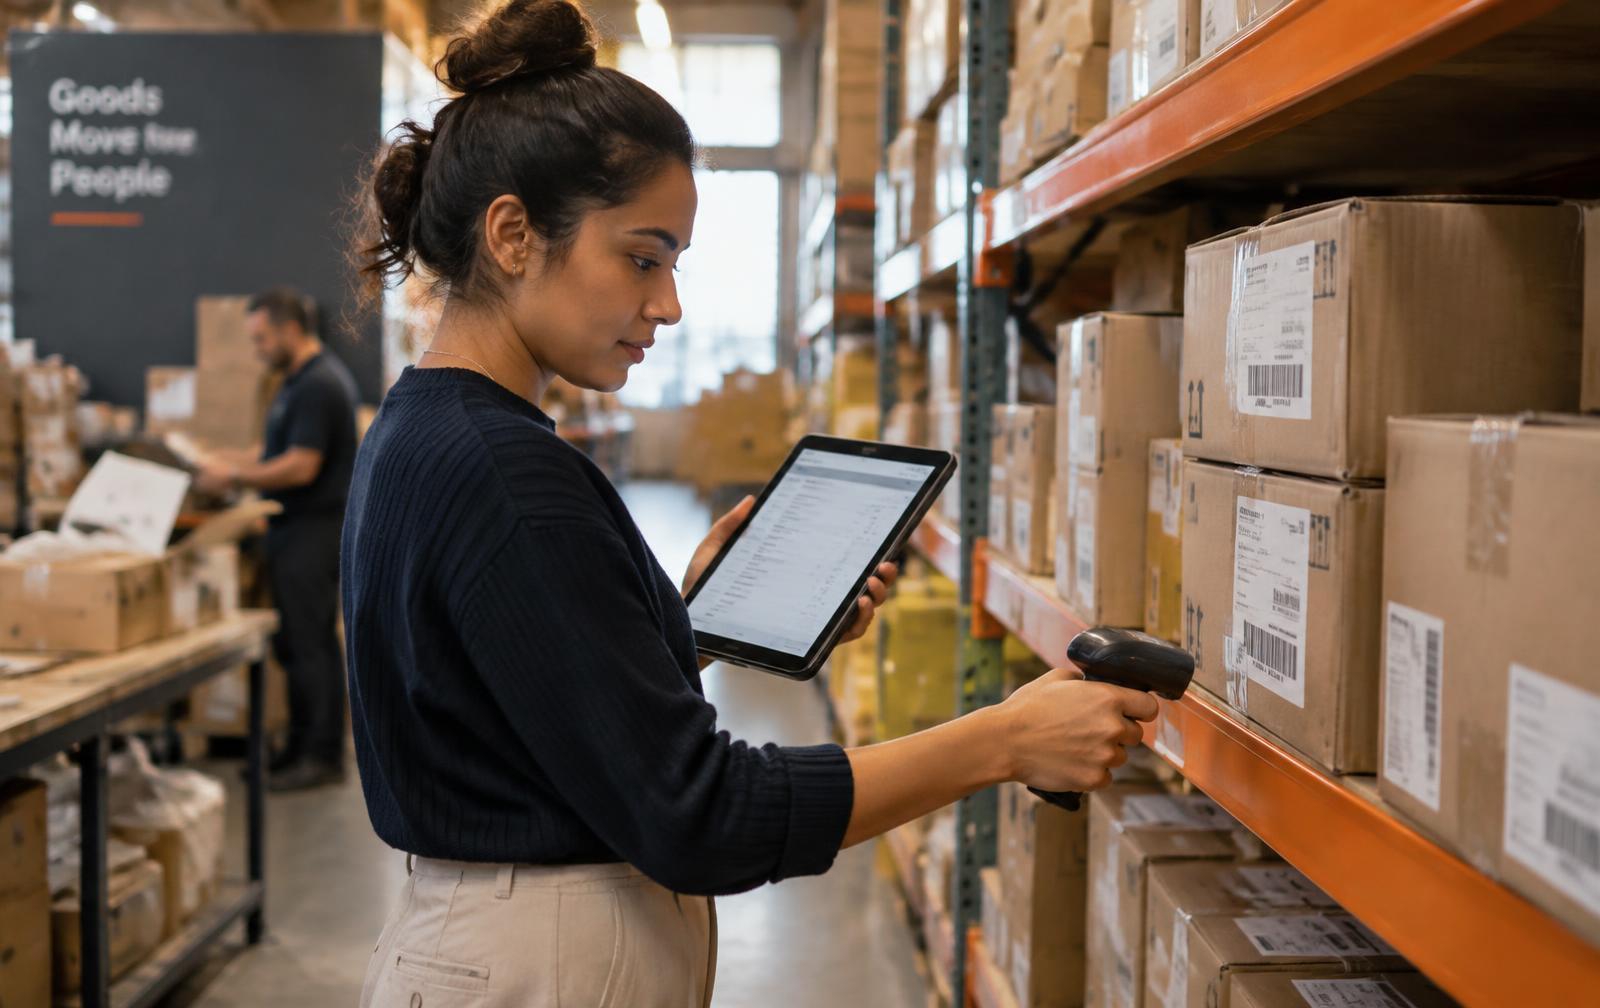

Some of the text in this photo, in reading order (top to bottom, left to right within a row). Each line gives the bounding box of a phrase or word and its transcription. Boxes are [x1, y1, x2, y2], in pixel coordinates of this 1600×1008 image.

[49, 79, 161, 114] Goods
[50, 120, 138, 153] Move
[50, 160, 170, 200] People
